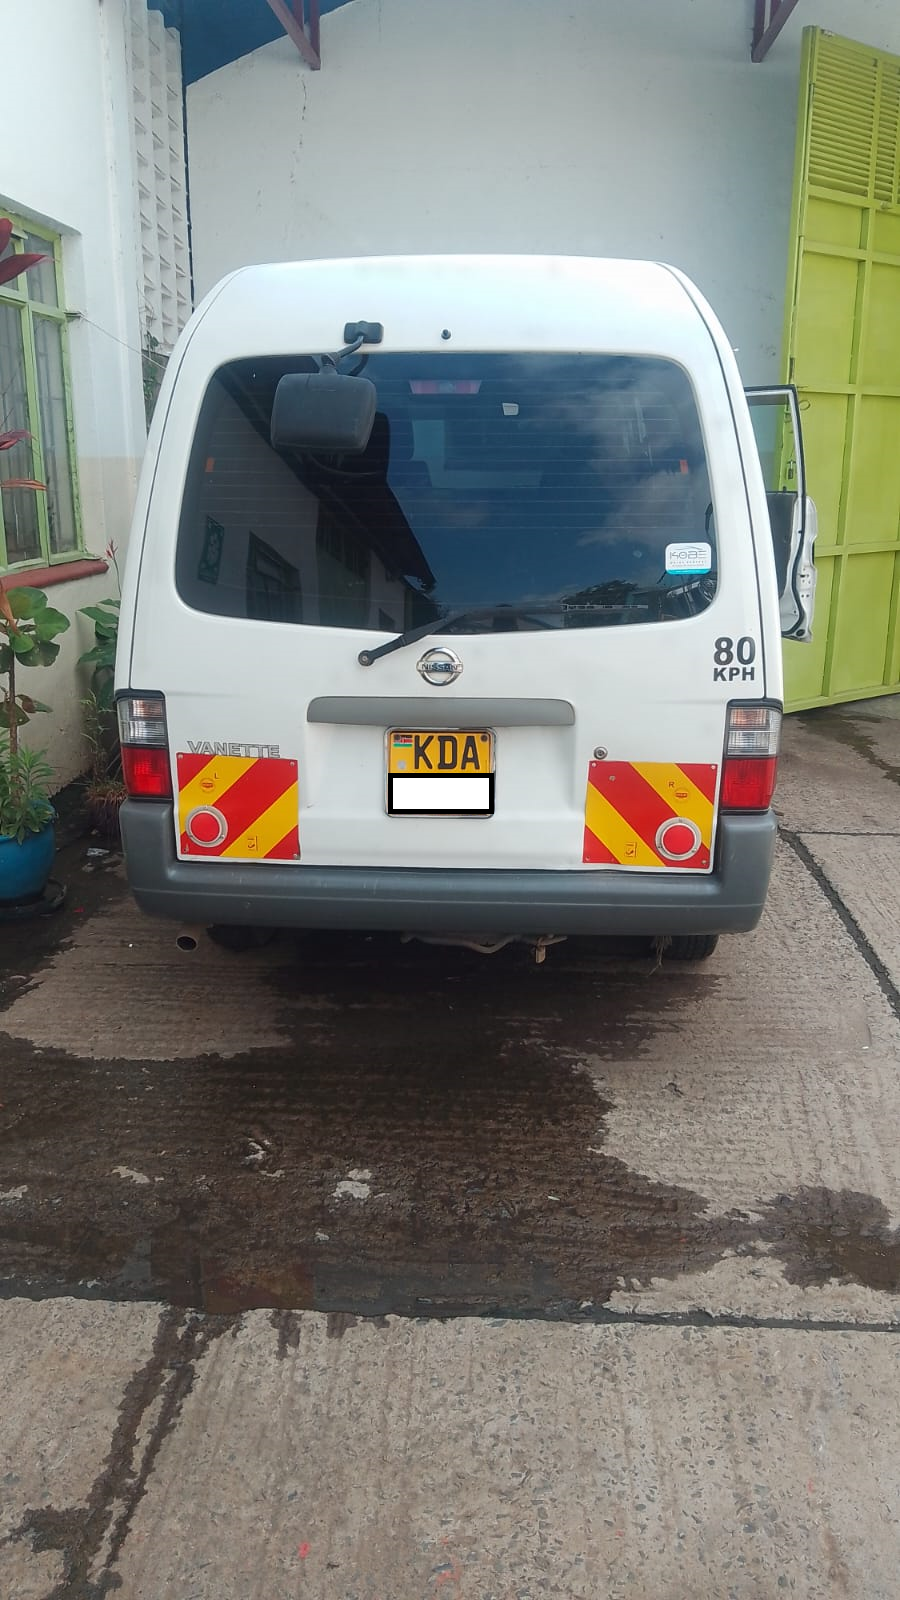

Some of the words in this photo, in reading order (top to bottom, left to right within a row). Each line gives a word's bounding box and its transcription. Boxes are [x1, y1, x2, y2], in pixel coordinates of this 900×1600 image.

[670, 550, 708, 560] KOBE
[713, 636, 756, 665] 80
[713, 666, 755, 681] KPH
[187, 740, 281, 759] VANETTE
[414, 735, 480, 770] KDA
